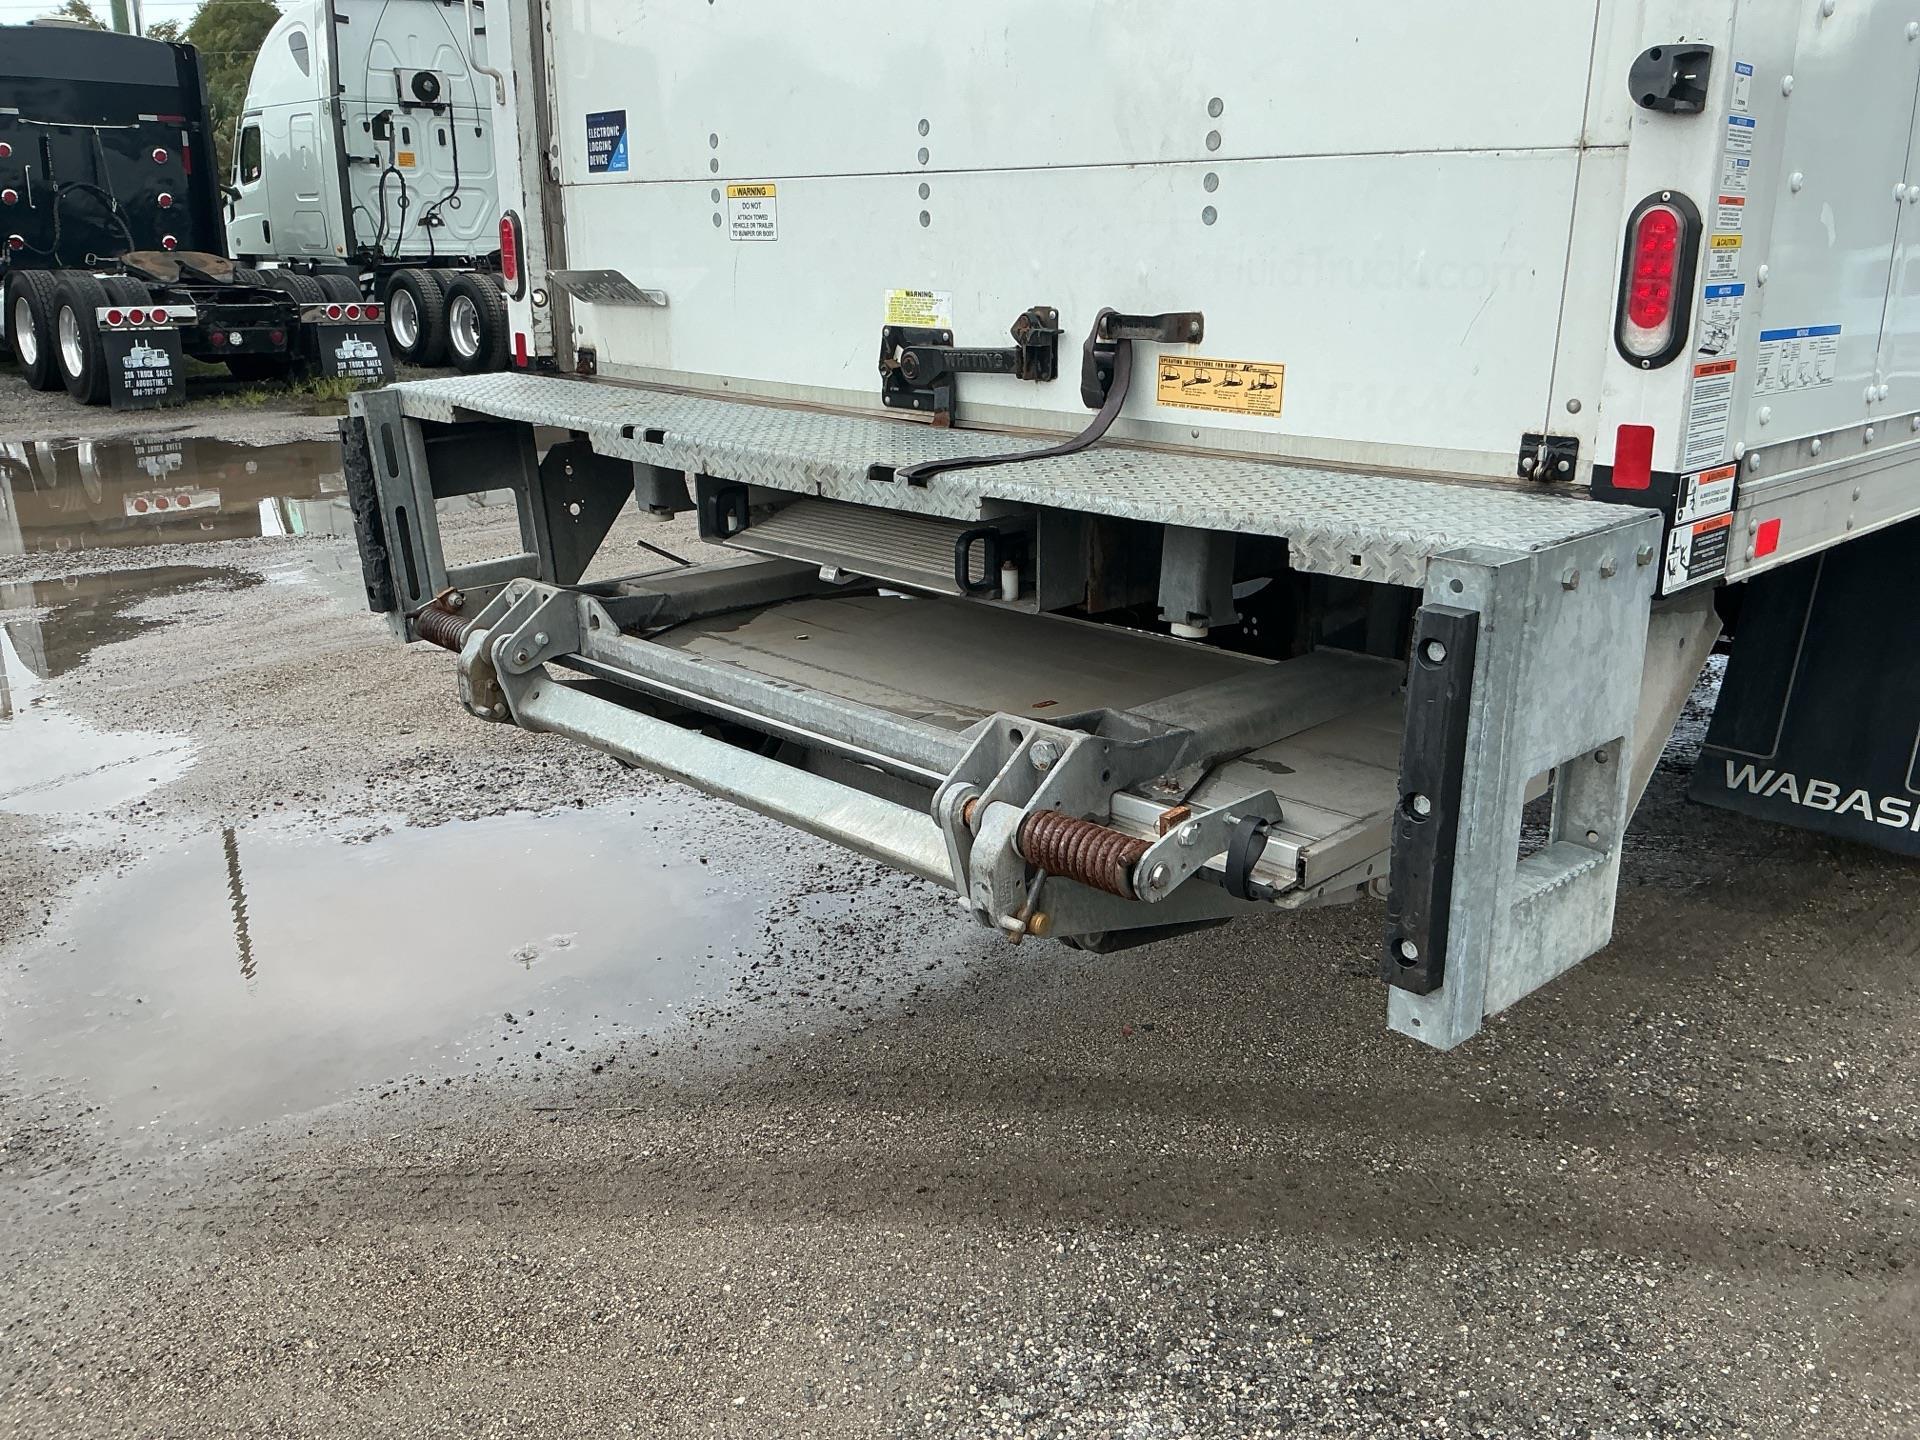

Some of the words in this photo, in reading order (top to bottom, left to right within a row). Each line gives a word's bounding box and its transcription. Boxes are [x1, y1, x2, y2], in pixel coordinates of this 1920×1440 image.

[588, 125, 620, 139] ELECTRONIC
[589, 140, 611, 152] LOGGING
[590, 154, 608, 166] DEVICE
[737, 187, 766, 196] WARNING
[348, 360, 365, 368] TRUCK
[366, 359, 382, 367] SALES
[1184, 360, 1214, 368] INSTRUCTIONS
[136, 370, 154, 378] TRUCK
[155, 369, 173, 378] SALES
